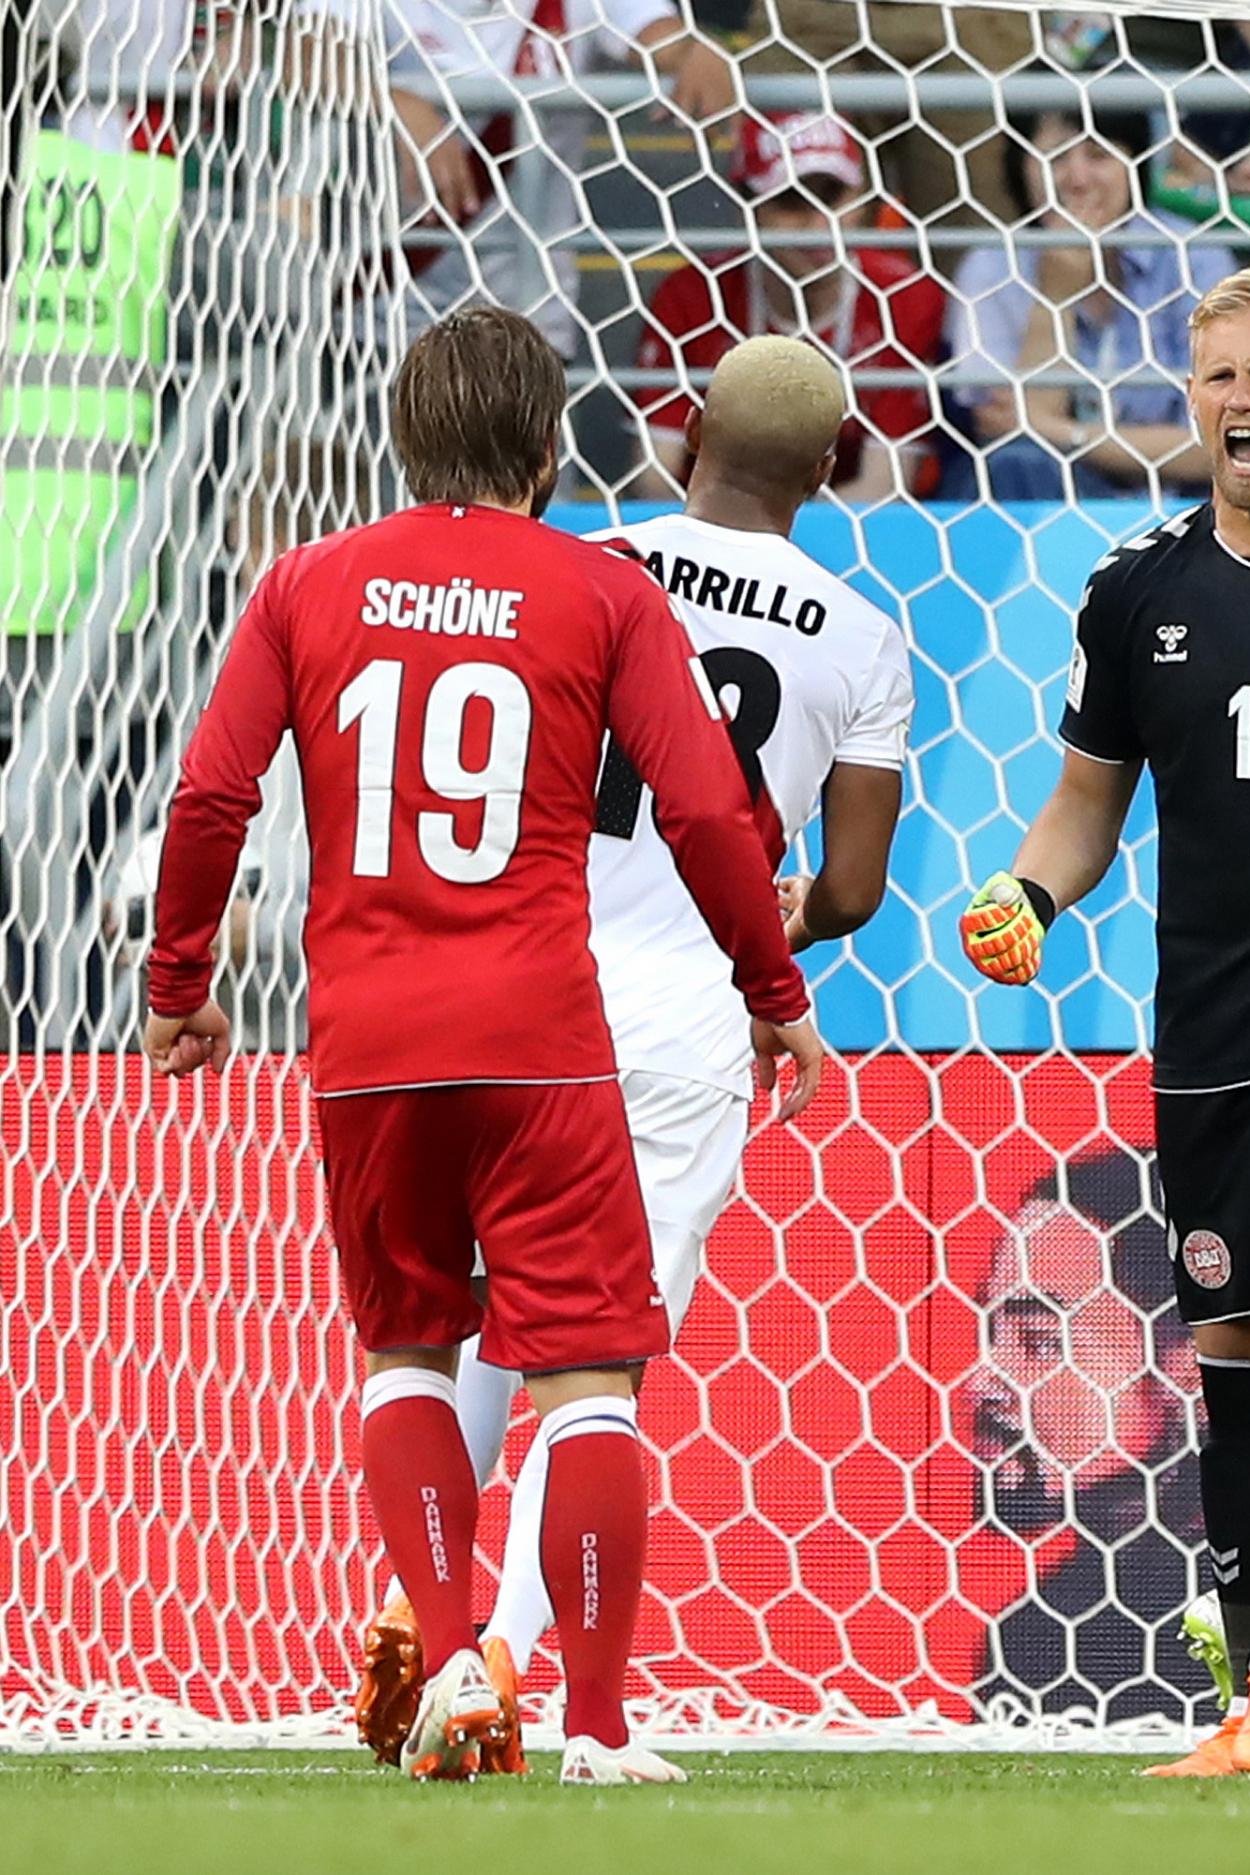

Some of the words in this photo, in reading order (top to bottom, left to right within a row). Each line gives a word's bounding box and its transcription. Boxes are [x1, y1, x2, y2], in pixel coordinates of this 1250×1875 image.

[361, 577, 524, 639] SCHÖNE
[626, 549, 827, 637] ARRILLO
[337, 659, 532, 884] 19
[421, 1487, 451, 1583] DANMARK
[581, 1533, 600, 1630] DANMARK
